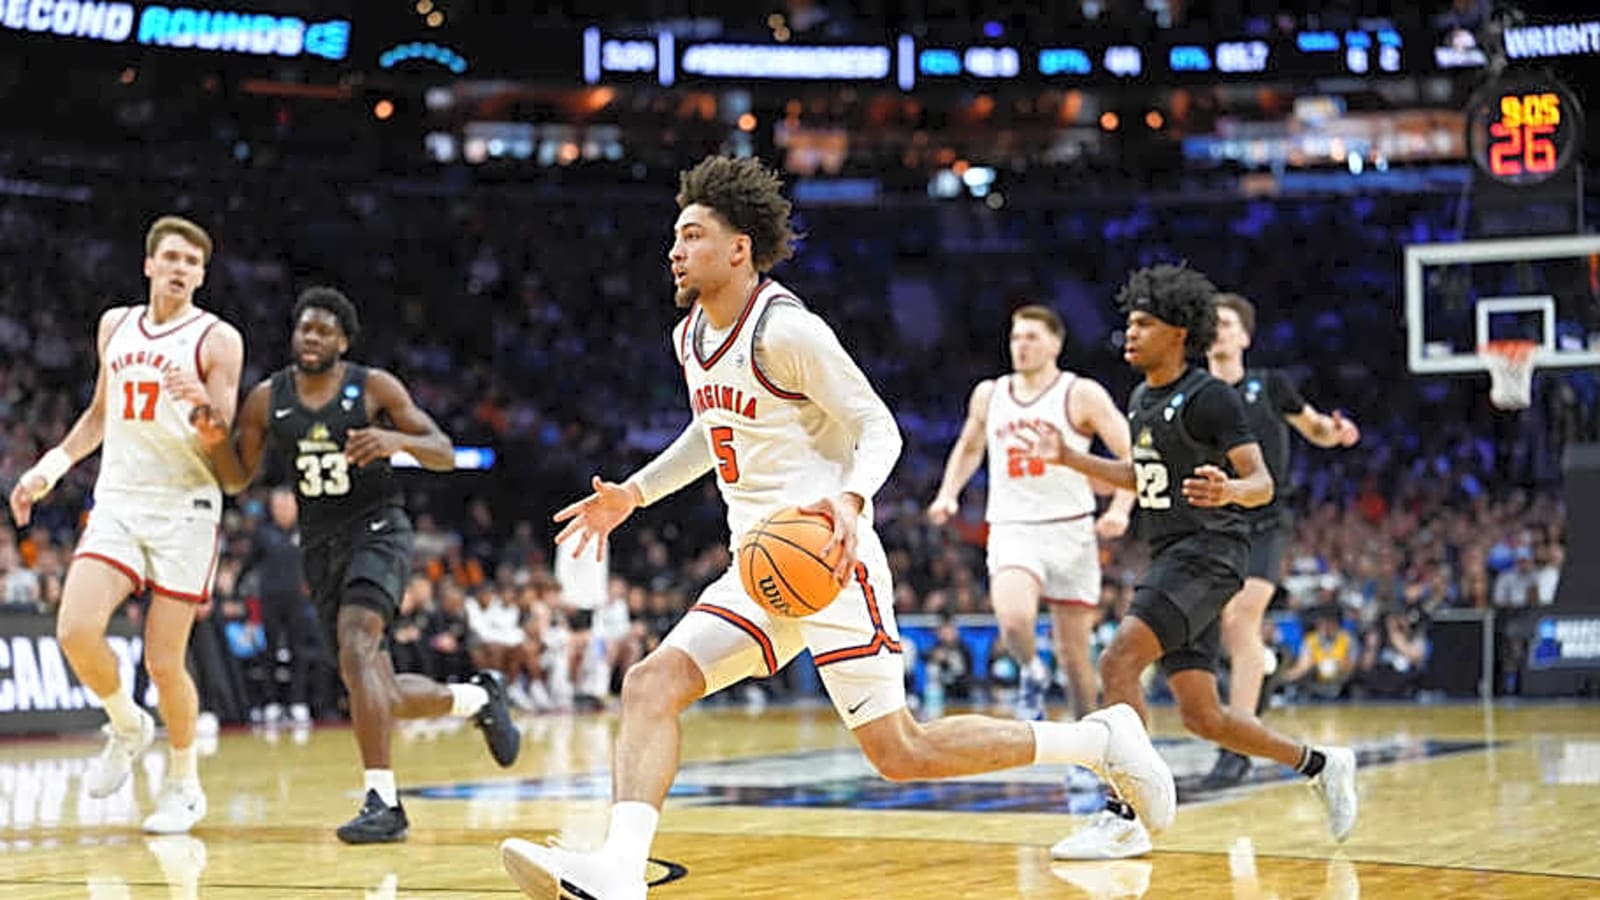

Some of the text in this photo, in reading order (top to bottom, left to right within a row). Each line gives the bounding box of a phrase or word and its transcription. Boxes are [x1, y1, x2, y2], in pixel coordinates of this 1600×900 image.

[0, 0, 304, 56] ECOND ROUNDS
[1504, 22, 1600, 58] WRIGHT
[1490, 122, 1556, 174] 26
[111, 351, 170, 374] VIRGINI
[124, 381, 160, 421] 17
[296, 453, 351, 496] 33
[711, 426, 739, 483] 5
